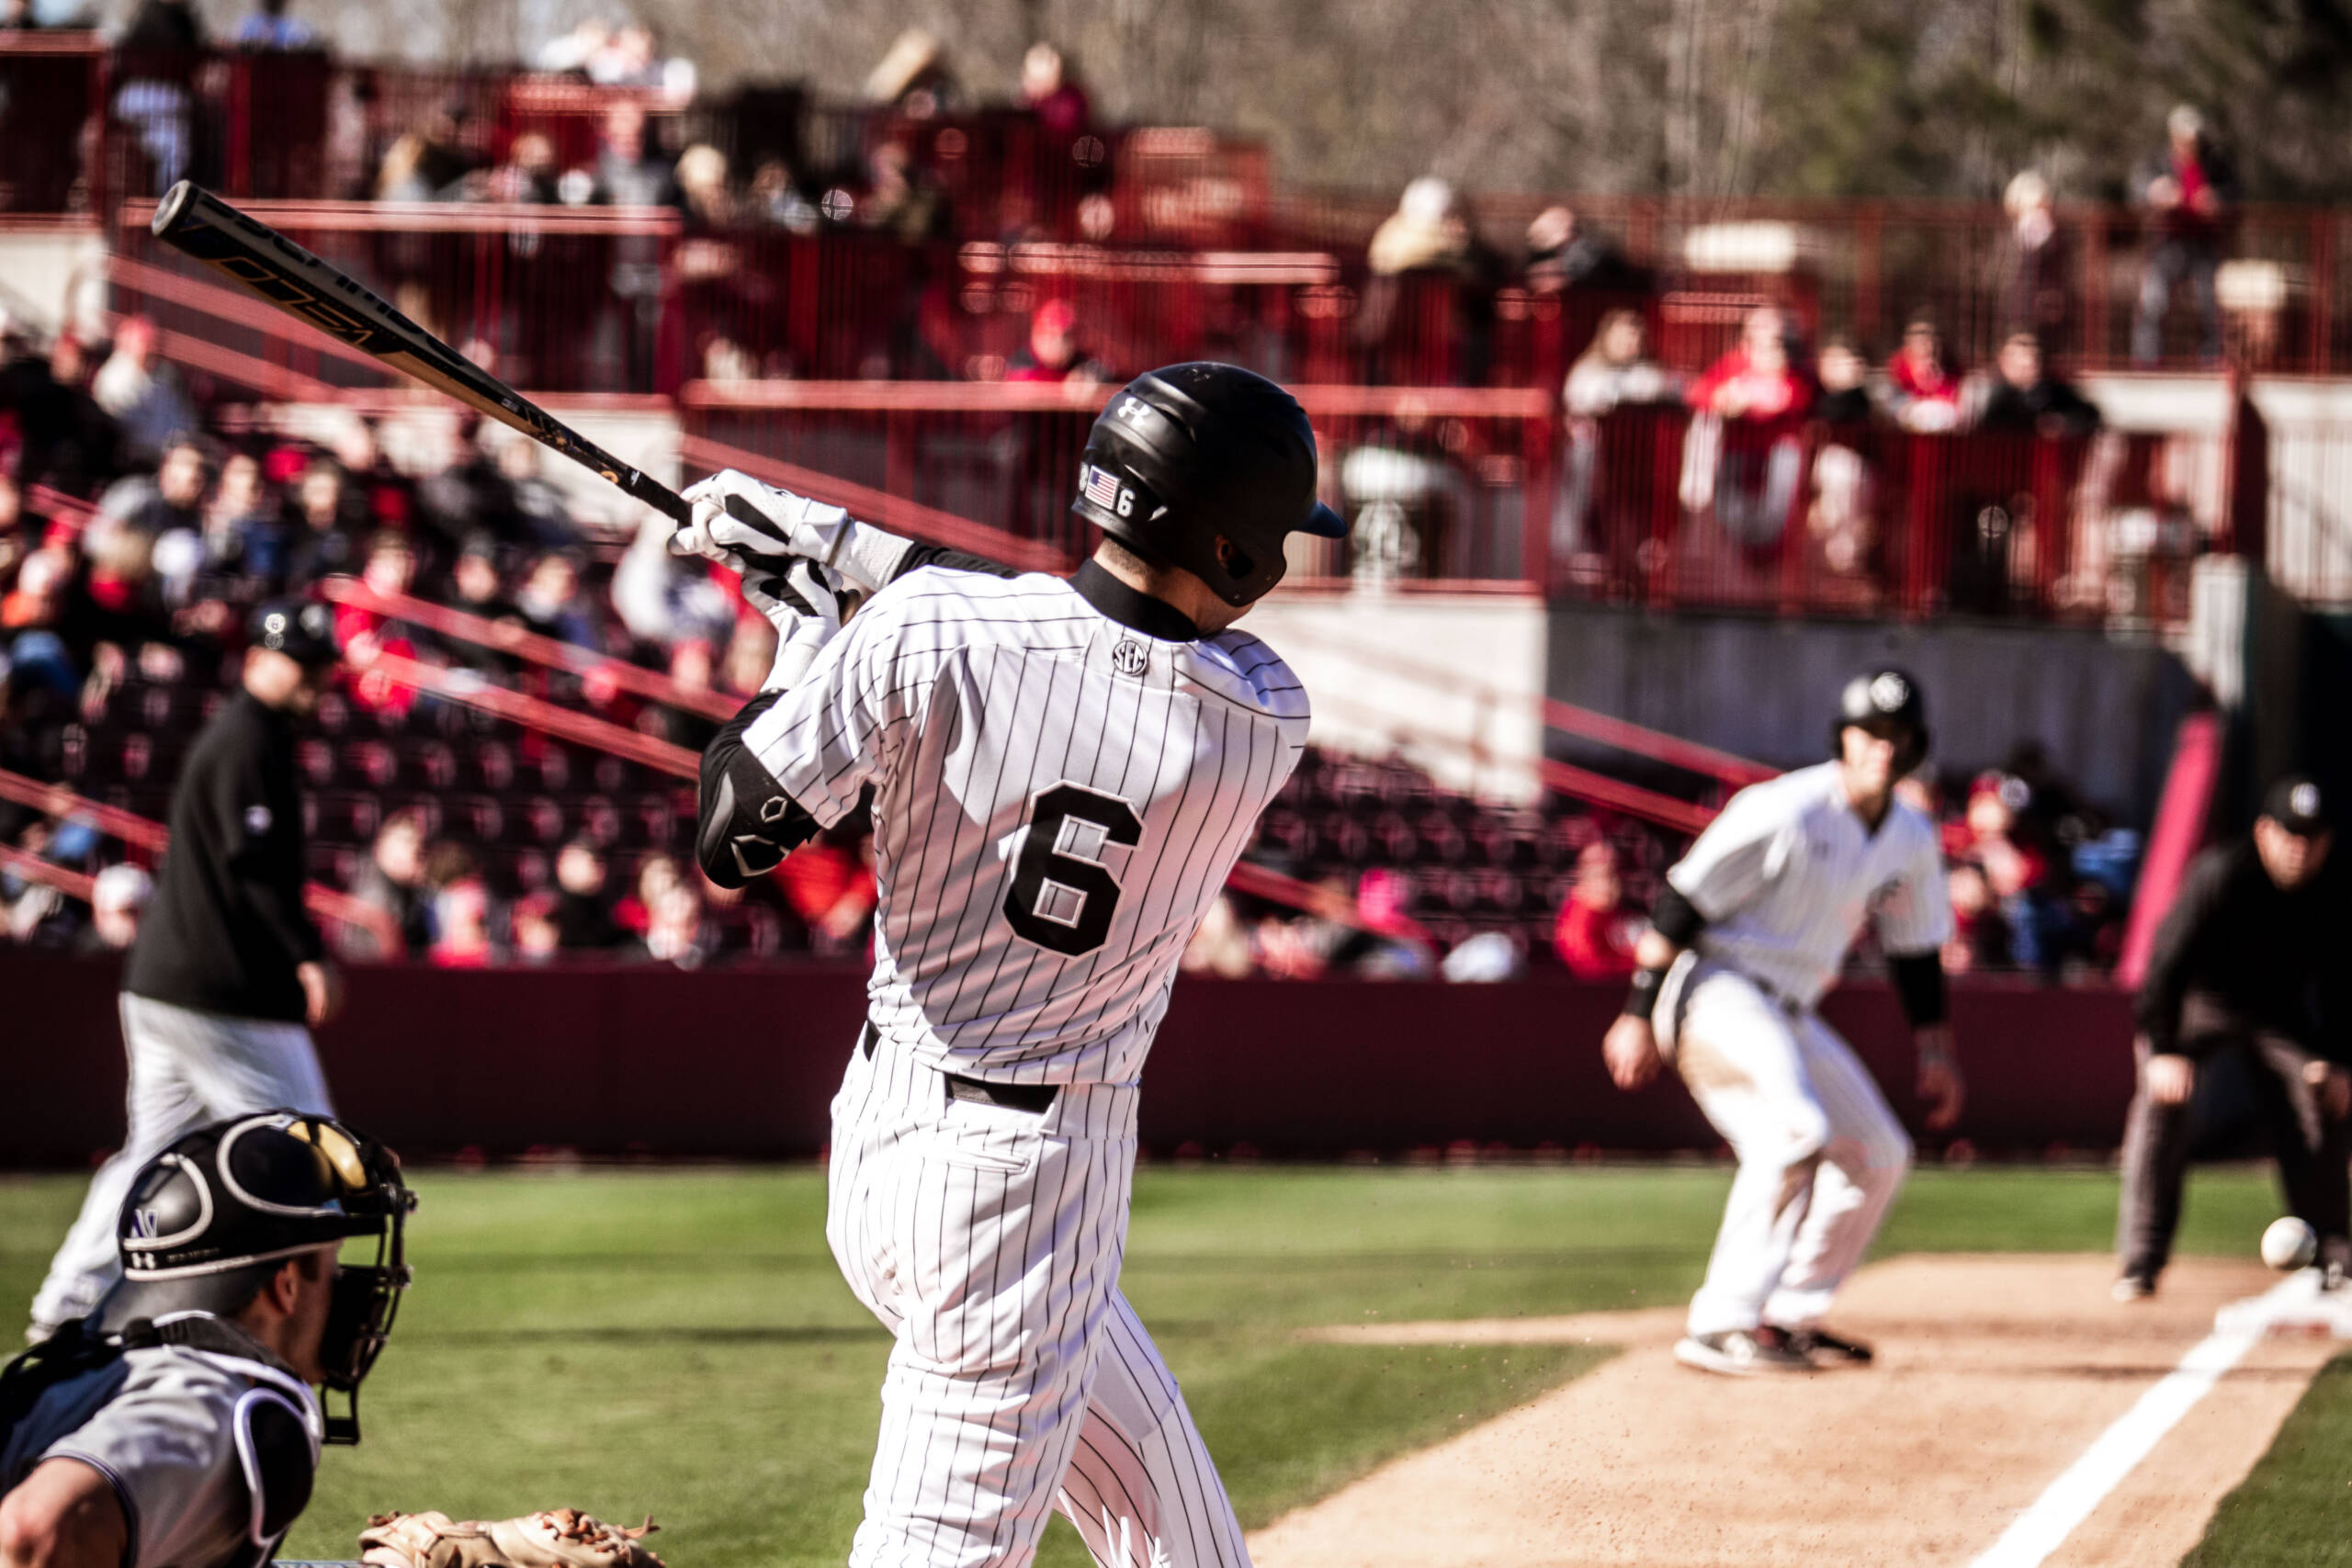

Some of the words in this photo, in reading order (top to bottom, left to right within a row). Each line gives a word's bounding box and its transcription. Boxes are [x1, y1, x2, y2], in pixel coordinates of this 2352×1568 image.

[1116, 489, 1136, 517] 6
[1113, 640, 1146, 674] SEC
[1002, 779, 1147, 960] 6
